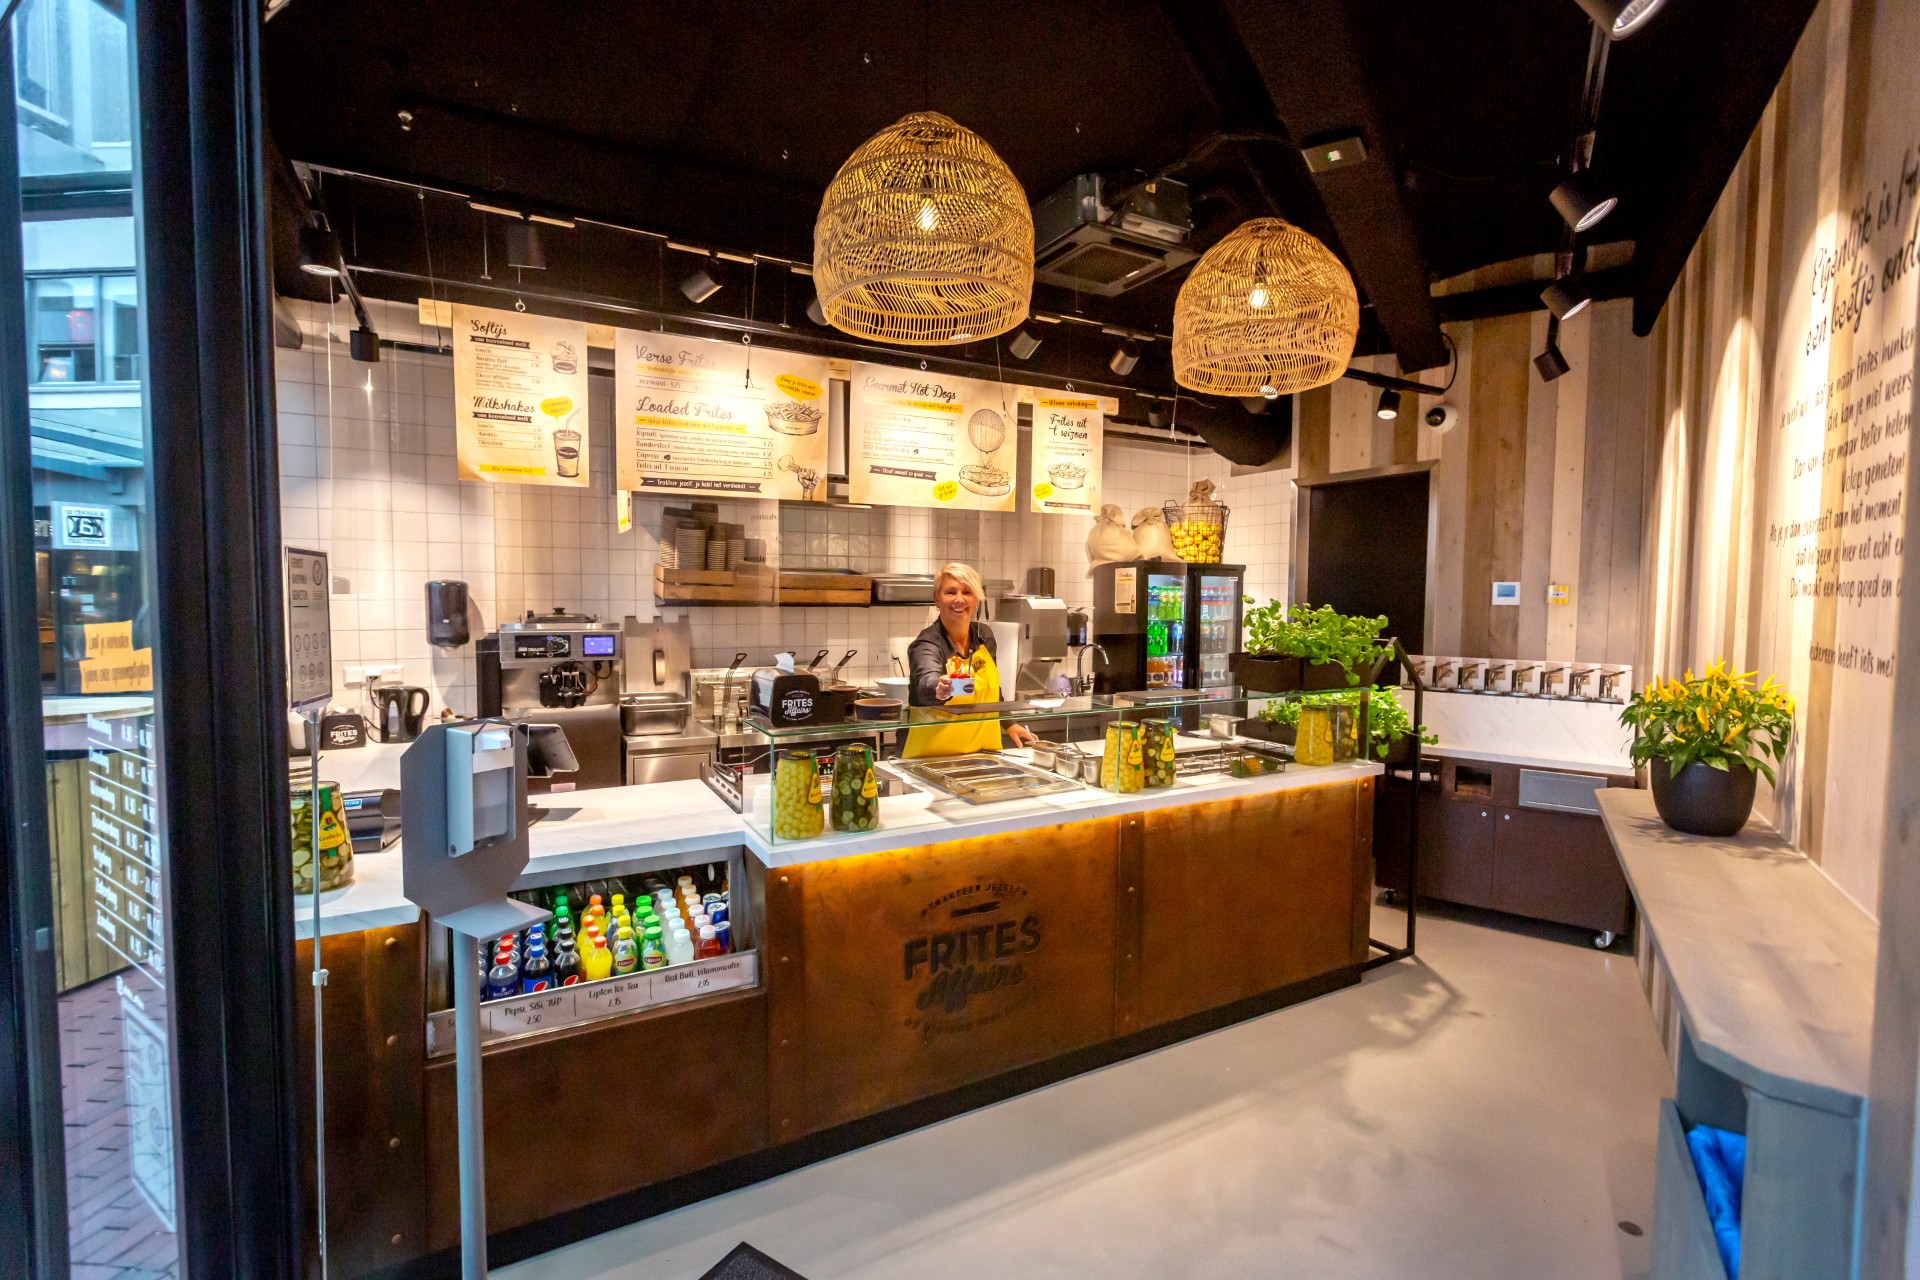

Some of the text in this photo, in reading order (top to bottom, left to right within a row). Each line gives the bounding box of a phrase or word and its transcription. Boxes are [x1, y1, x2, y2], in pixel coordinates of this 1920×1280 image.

[1811, 181, 1891, 304] Eigenlijk is
[1806, 261, 1875, 356] een beetje
[471, 319, 507, 339] Softijs
[635, 344, 716, 370] Verse Frites
[639, 378, 666, 387] normaal
[863, 376, 906, 394] Gourmet
[910, 382, 930, 397] Hot
[932, 384, 957, 404] Dogs
[1780, 410, 1786, 429] Je
[1786, 399, 1799, 425] weet
[1825, 379, 1834, 410] je
[1836, 367, 1855, 394] naar
[1856, 350, 1879, 381] frites
[473, 395, 536, 414] Milkshakes
[635, 396, 733, 420] Loaded Frites
[1828, 407, 1839, 432] die
[1840, 401, 1854, 424] kan
[1854, 395, 1864, 428] je
[1866, 379, 1883, 411] niet
[1049, 413, 1091, 429] Frites uit
[1060, 428, 1088, 440] seizoen
[1827, 447, 1836, 466] er
[1837, 437, 1859, 461] maar
[1860, 421, 1883, 451] beter
[636, 452, 660, 461] Caprese
[636, 462, 652, 471] Frites
[653, 463, 662, 471] uit
[657, 478, 678, 487] Trakteer
[1841, 451, 1906, 497] Volop genieten!
[1776, 525, 1783, 548] je
[1789, 519, 1801, 538] dan
[1801, 507, 1833, 542] overgeeft
[1833, 510, 1849, 529] aan
[1850, 499, 1863, 526] het
[1796, 547, 1807, 567] dat
[1832, 545, 1840, 572] je
[1841, 539, 1857, 562] hier
[1858, 535, 1872, 560] eet
[1873, 531, 1893, 560] echt
[1790, 572, 1892, 608] Dat maakt een hoop goed en
[1837, 643, 1858, 670] heeft
[1859, 648, 1874, 674] iets
[1876, 653, 1895, 678] met
[781, 698, 813, 709] FRITES
[784, 706, 812, 717] Affairs
[330, 729, 358, 738] FRITES
[903, 914, 1041, 982] FRITES
[617, 958, 635, 967] Lipton
[644, 955, 662, 964] Lipton
[664, 973, 678, 984] Red
[696, 961, 742, 977] Vitaminwater
[589, 981, 639, 1001] Lipton Ice Tea
[547, 997, 563, 1008] 7UP
[527, 1015, 542, 1026] 2.50
